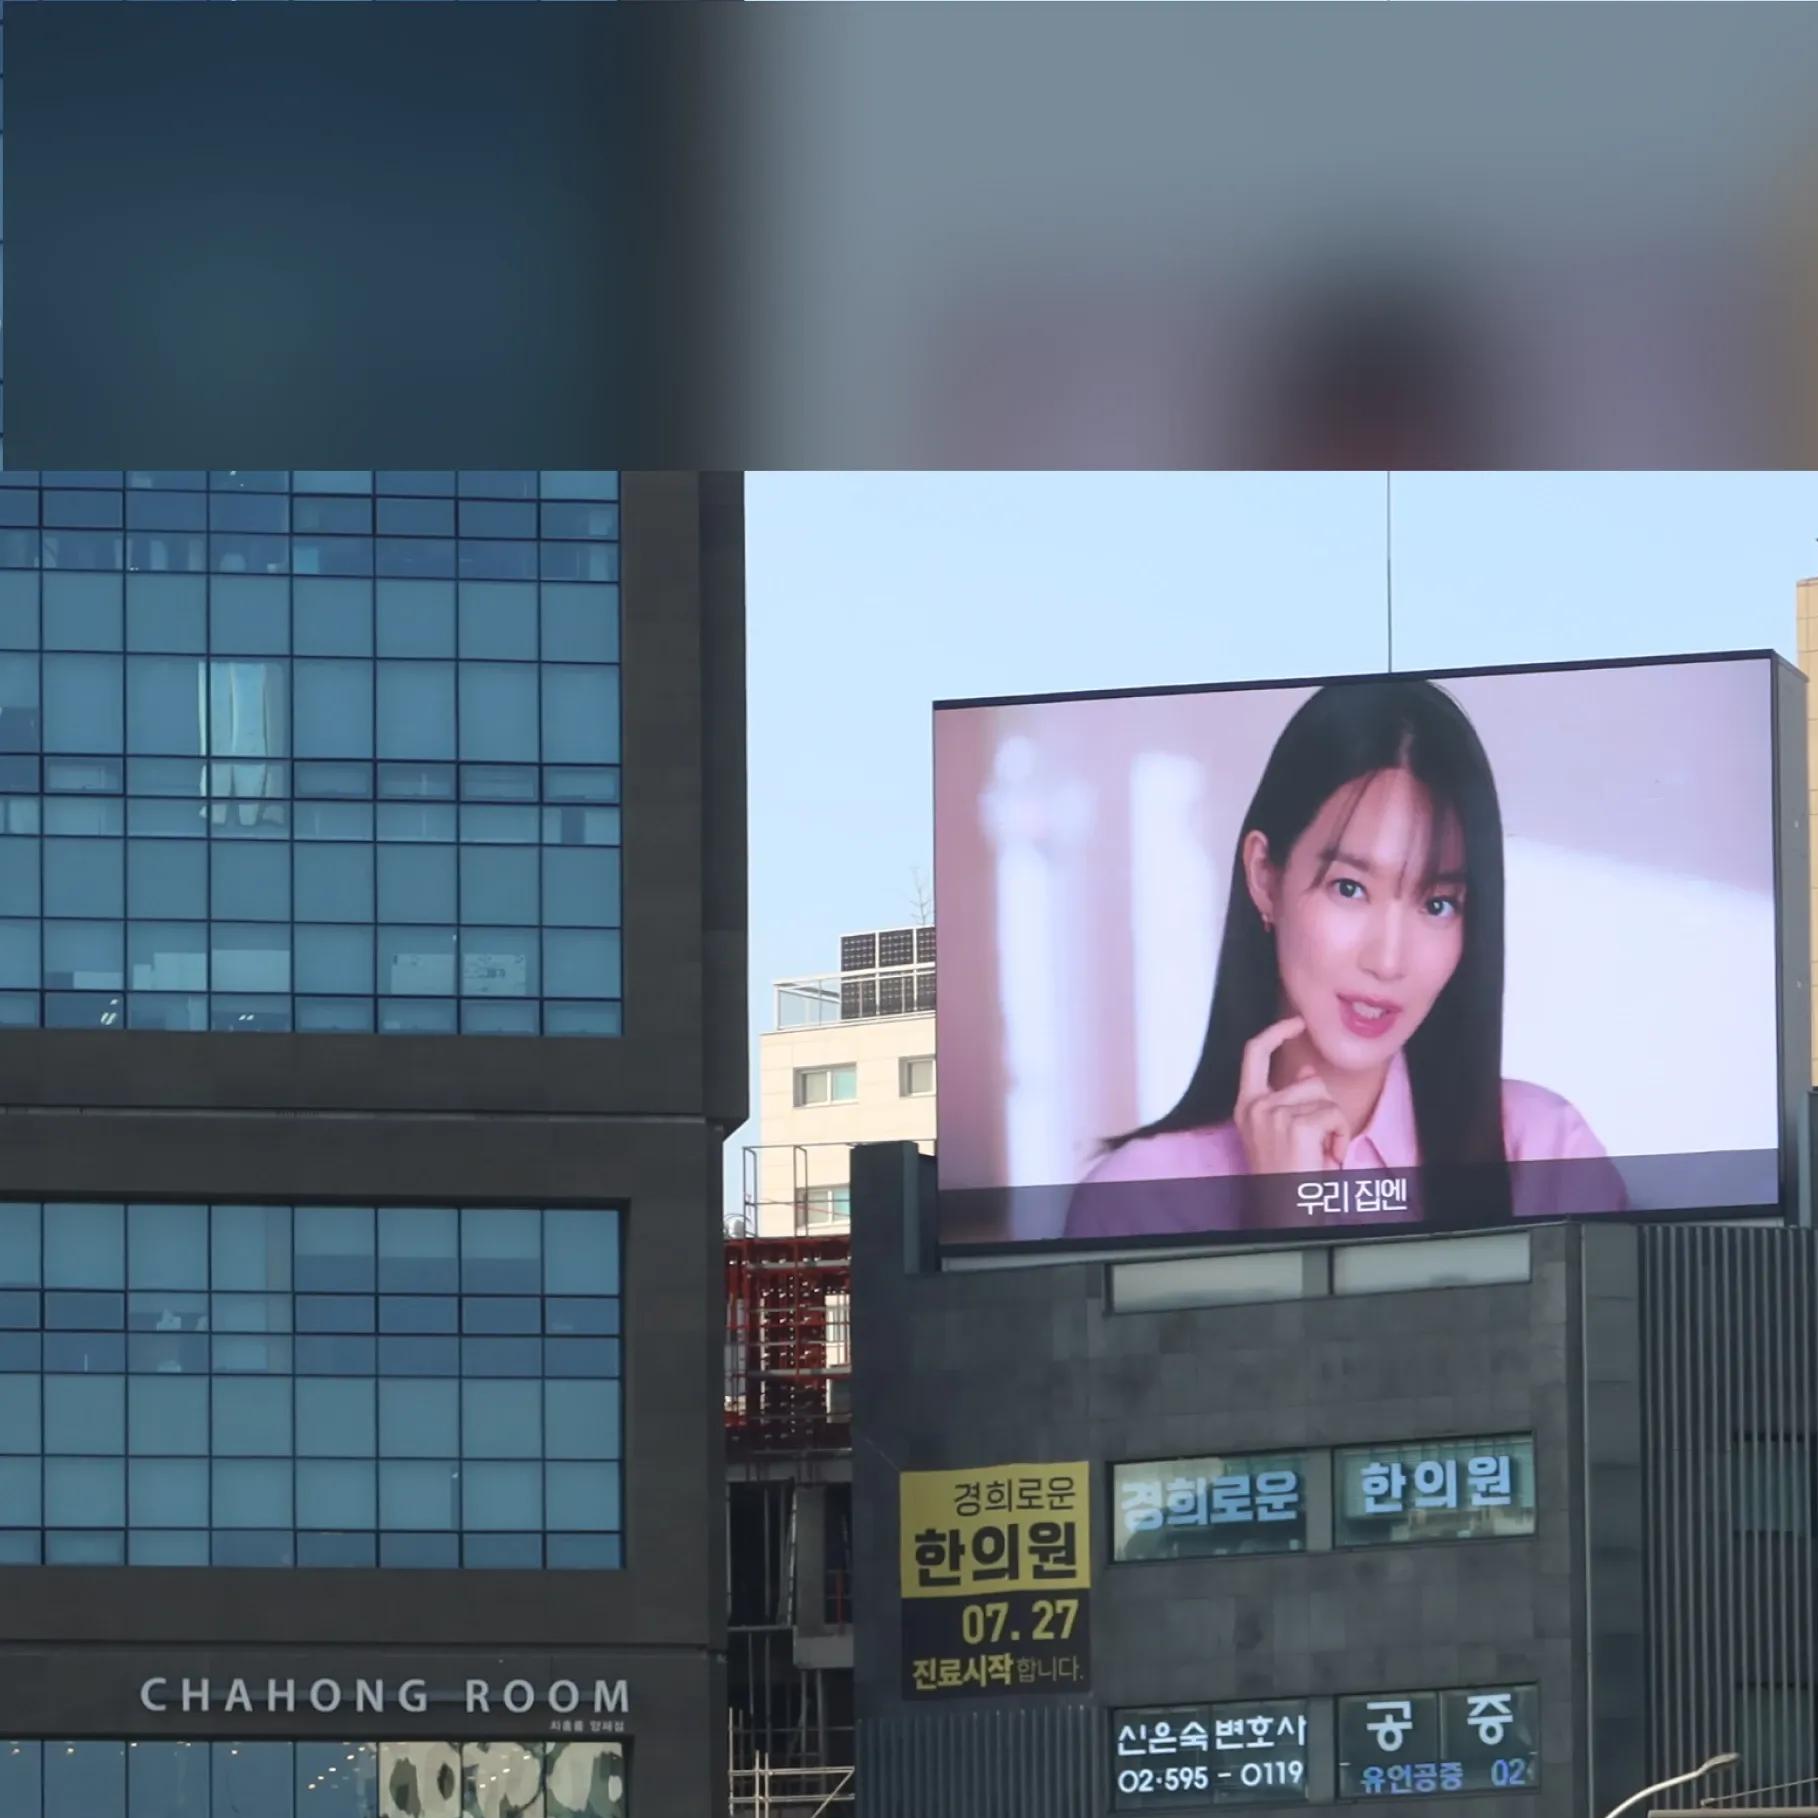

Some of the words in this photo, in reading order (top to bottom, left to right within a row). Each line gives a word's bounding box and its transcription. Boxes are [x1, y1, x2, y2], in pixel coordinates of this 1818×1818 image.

[1296, 1180, 1348, 1215] 우리
[1355, 1178, 1408, 1212] 집엔
[953, 1476, 1077, 1517] 경희로운
[1120, 1470, 1299, 1531] 경희로운
[1360, 1455, 1512, 1515] 한의원
[913, 1521, 1078, 1588] 한의원
[140, 1676, 429, 1714] CHAHONG
[465, 1678, 631, 1714] ROOM
